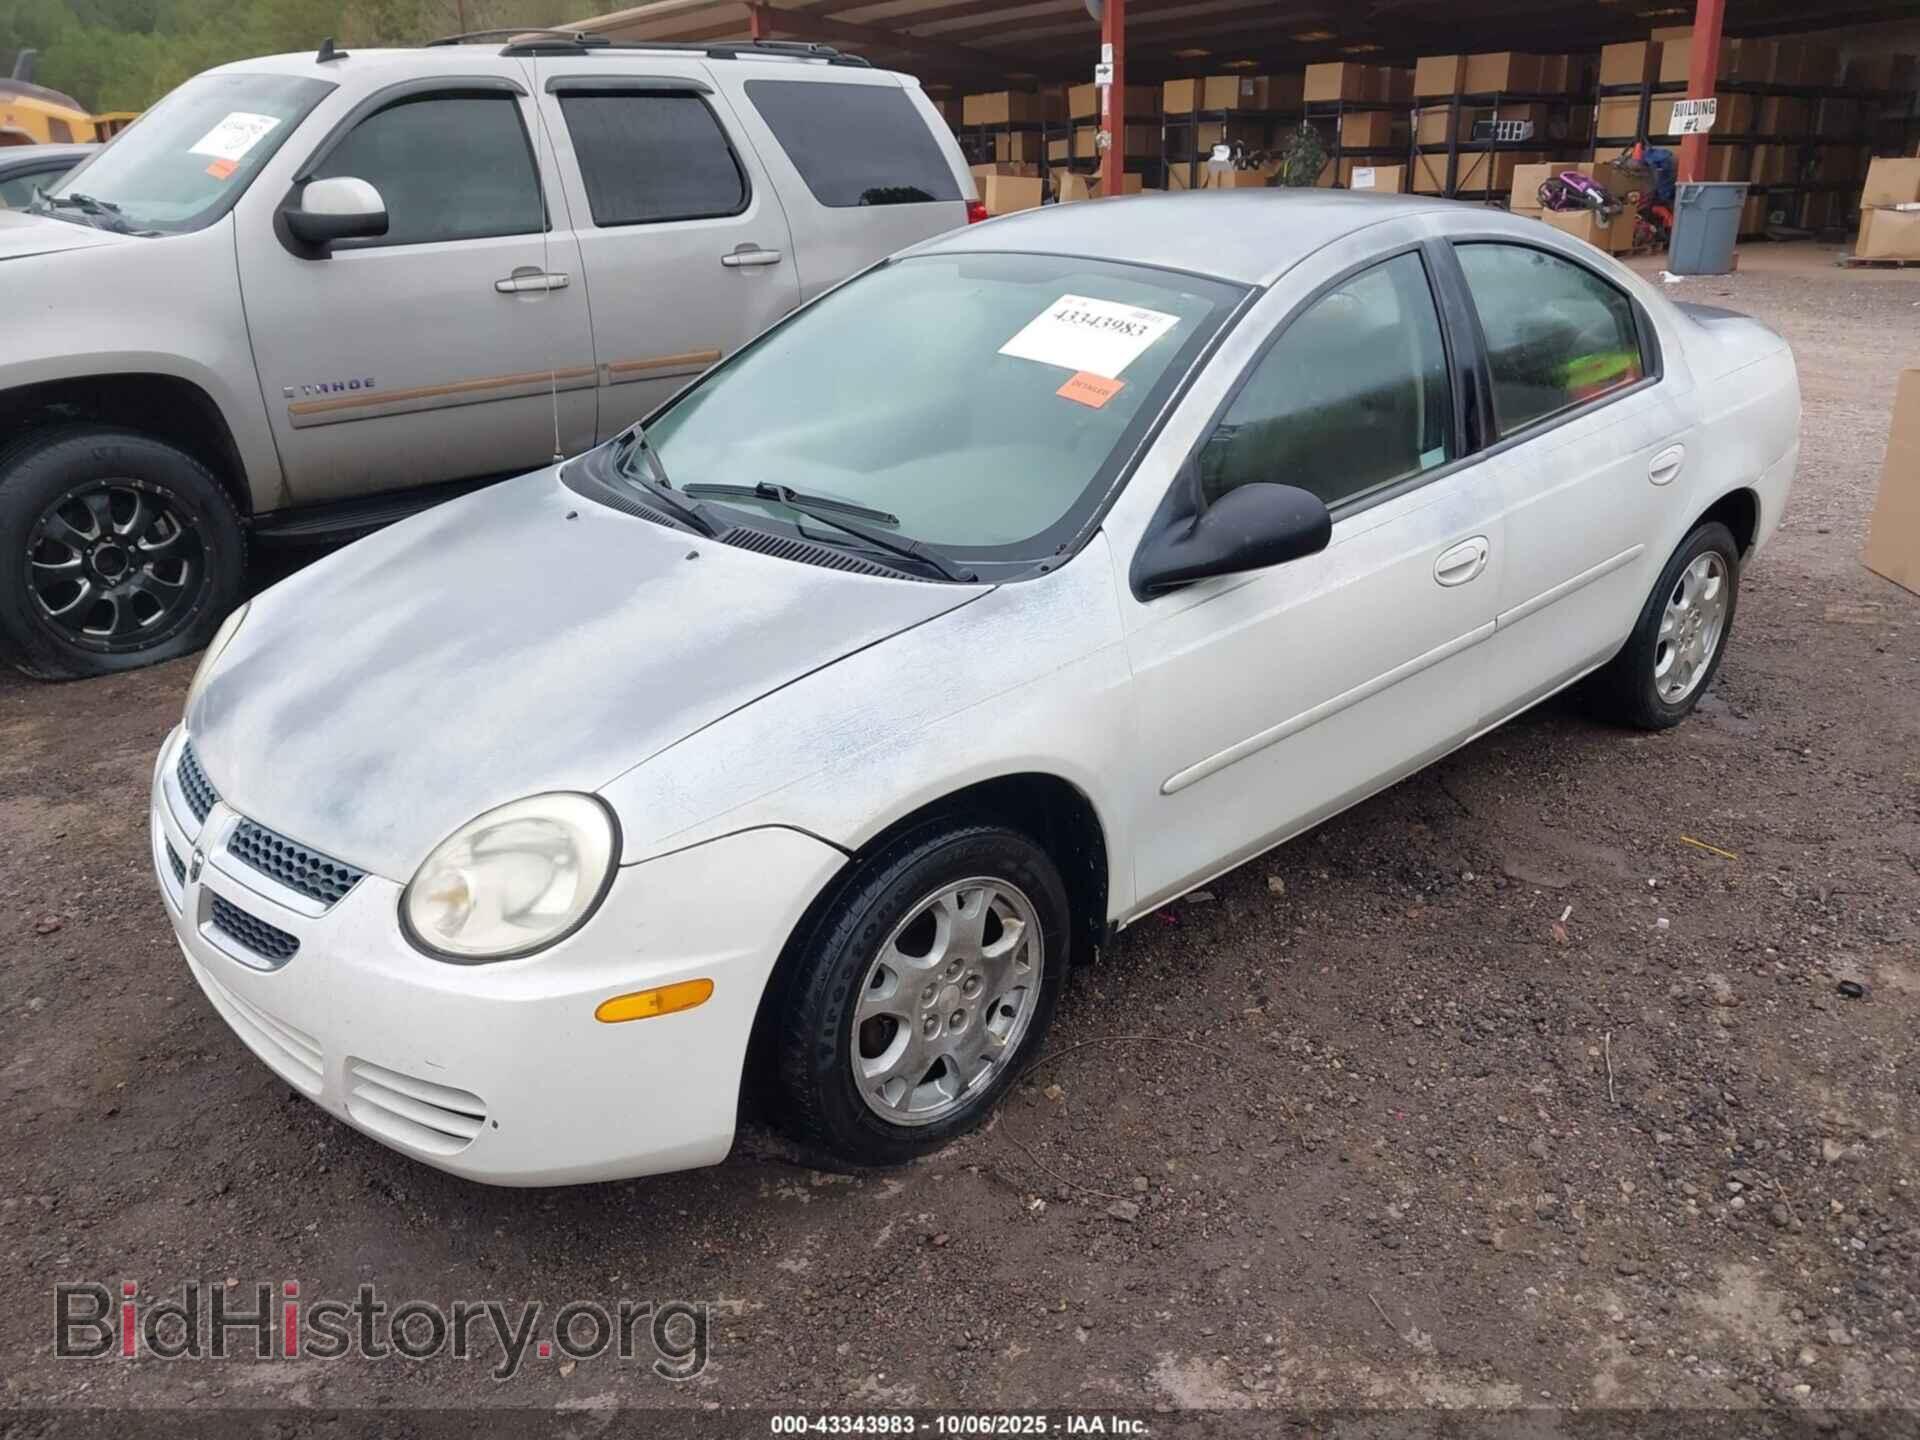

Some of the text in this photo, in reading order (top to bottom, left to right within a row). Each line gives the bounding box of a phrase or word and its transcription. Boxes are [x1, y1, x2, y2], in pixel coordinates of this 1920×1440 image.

[1674, 100, 1715, 117] BUILDING
[1684, 118, 1698, 132] #2
[1053, 309, 1148, 337] 43343983
[301, 377, 375, 396] TAHOE
